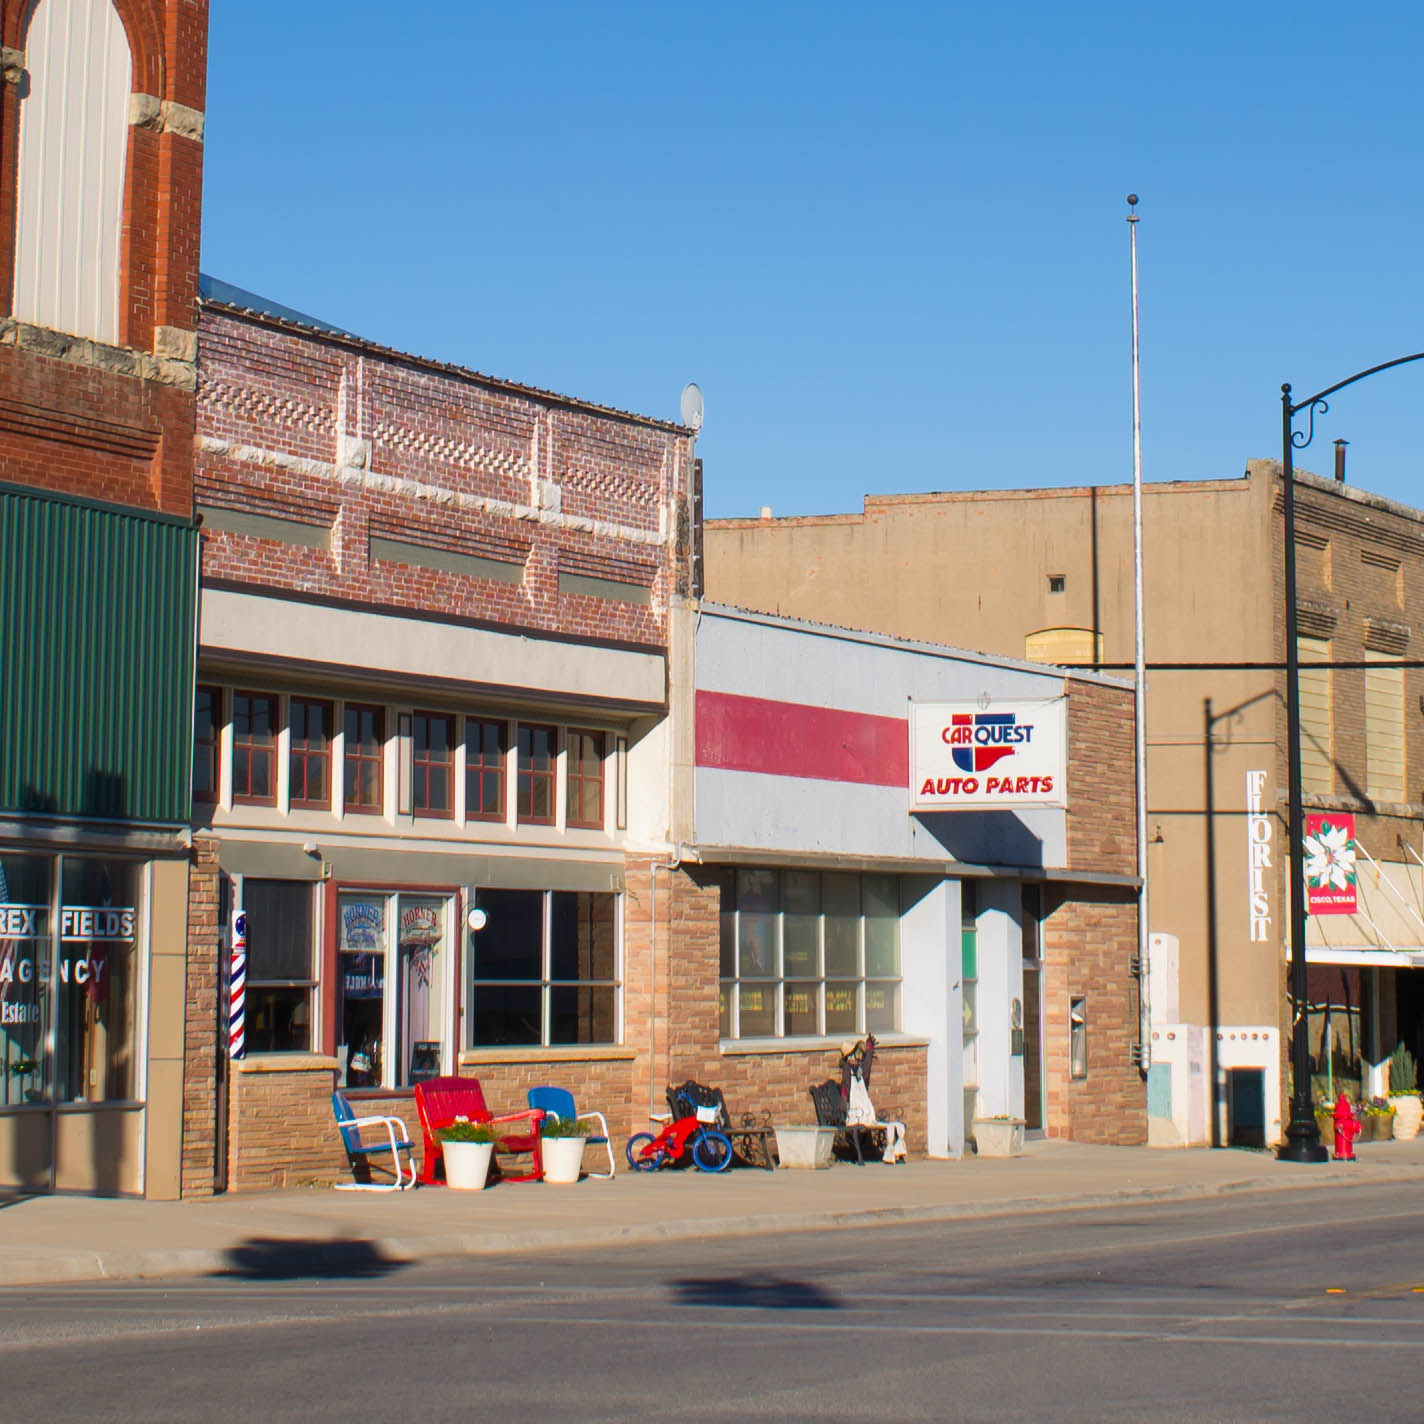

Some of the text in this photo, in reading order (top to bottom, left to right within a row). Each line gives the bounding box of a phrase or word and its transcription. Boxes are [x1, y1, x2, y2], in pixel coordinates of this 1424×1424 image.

[920, 775, 1054, 796] AUTO PARTS
[1248, 770, 1273, 942] FLORIST
[1332, 895, 1355, 904] TEXAS
[61, 911, 134, 937] FIELDS
[0, 957, 105, 984] AGENCY
[1, 1001, 40, 1023] Estate
